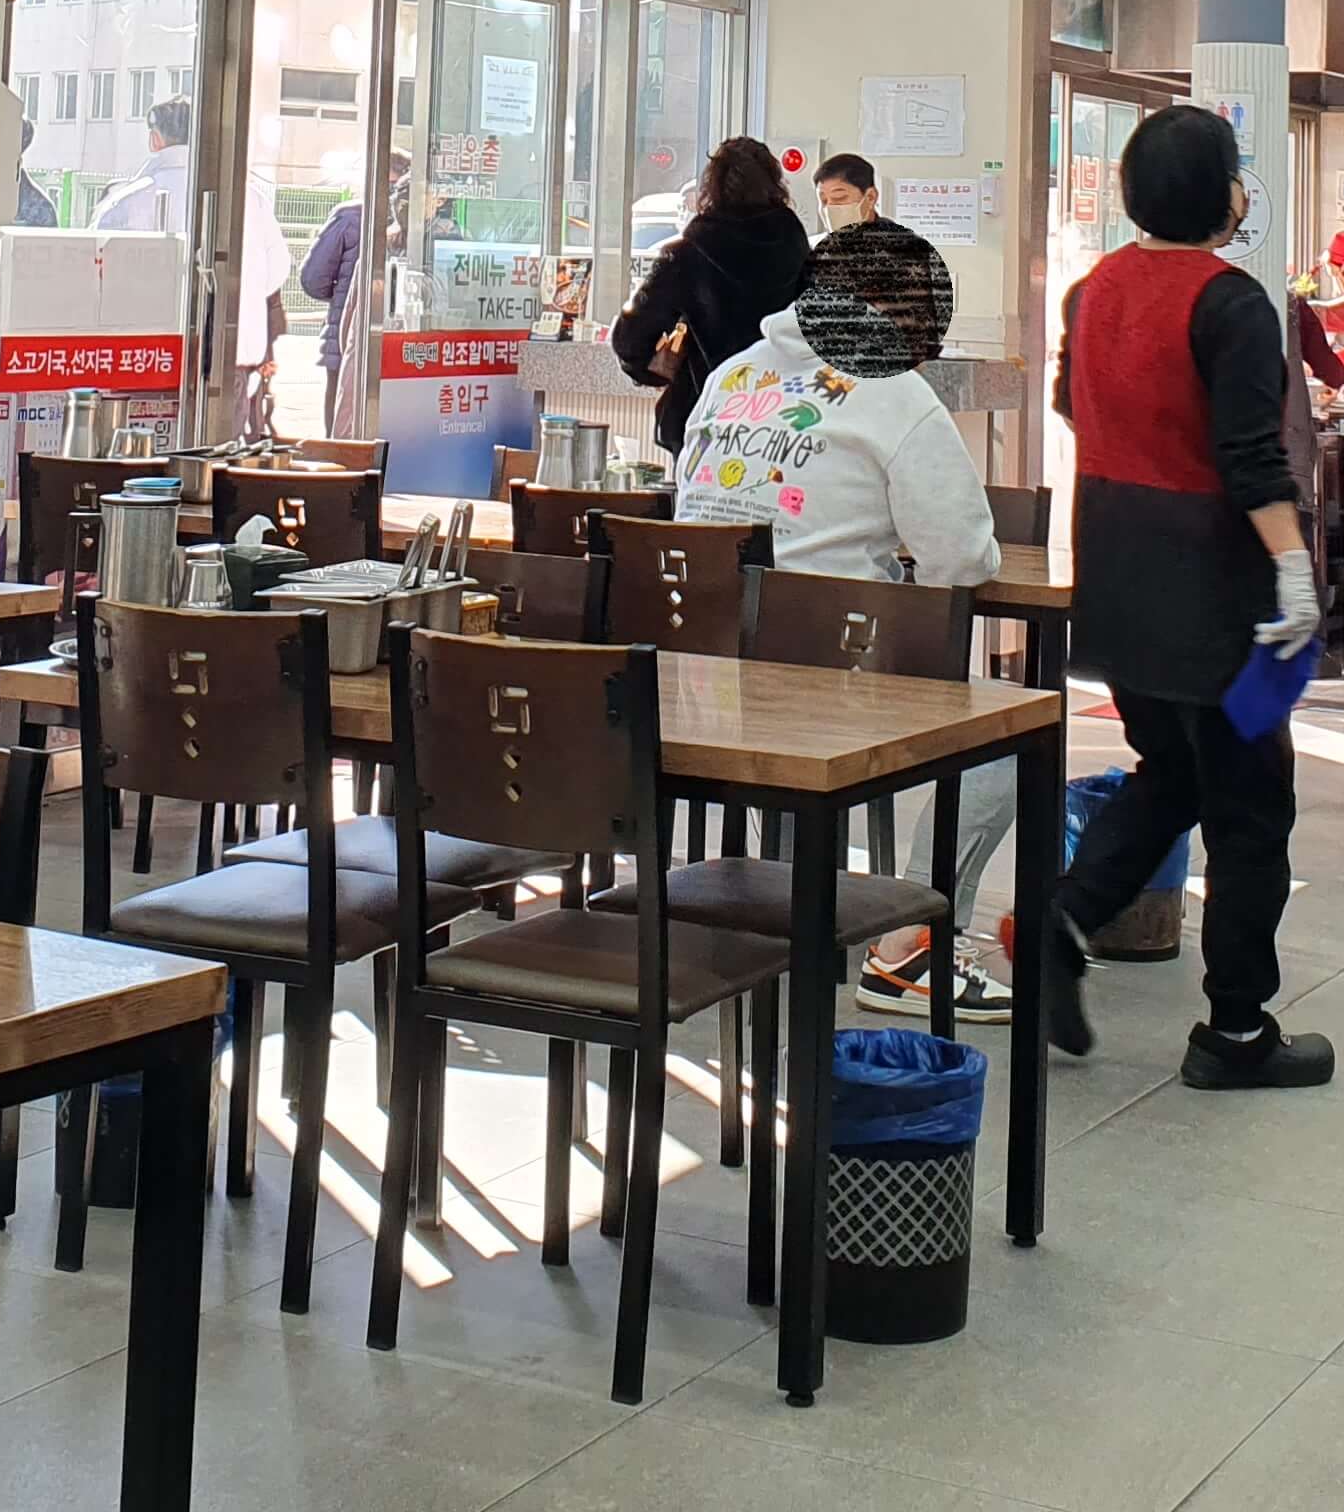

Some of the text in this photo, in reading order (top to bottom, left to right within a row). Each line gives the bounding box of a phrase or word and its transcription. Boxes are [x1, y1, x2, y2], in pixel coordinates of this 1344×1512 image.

[453, 253, 507, 288] 전메뉴
[6, 347, 174, 376] 소고기국,선지국 포장가능
[438, 383, 490, 415] 출입구
[717, 391, 783, 421] 2ND
